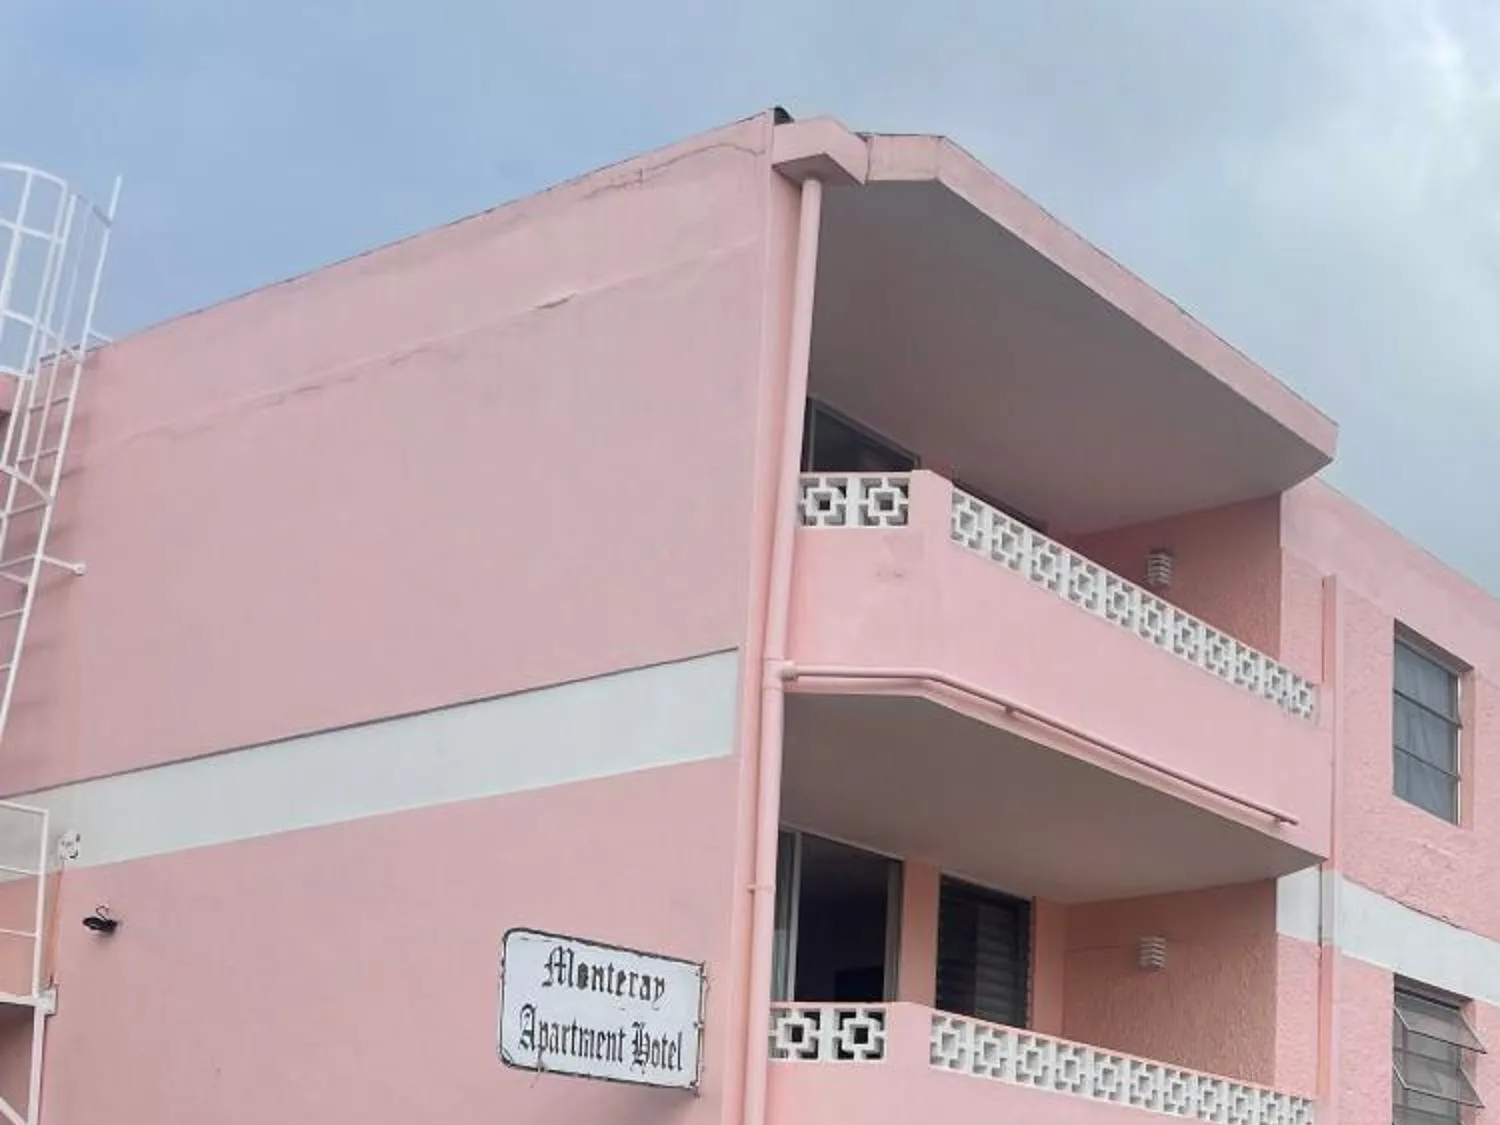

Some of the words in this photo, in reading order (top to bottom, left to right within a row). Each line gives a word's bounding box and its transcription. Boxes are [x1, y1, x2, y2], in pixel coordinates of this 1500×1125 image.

[541, 945, 665, 1011] Monteray
[518, 1003, 626, 1063] Apartment
[630, 1021, 683, 1074] Hotel
